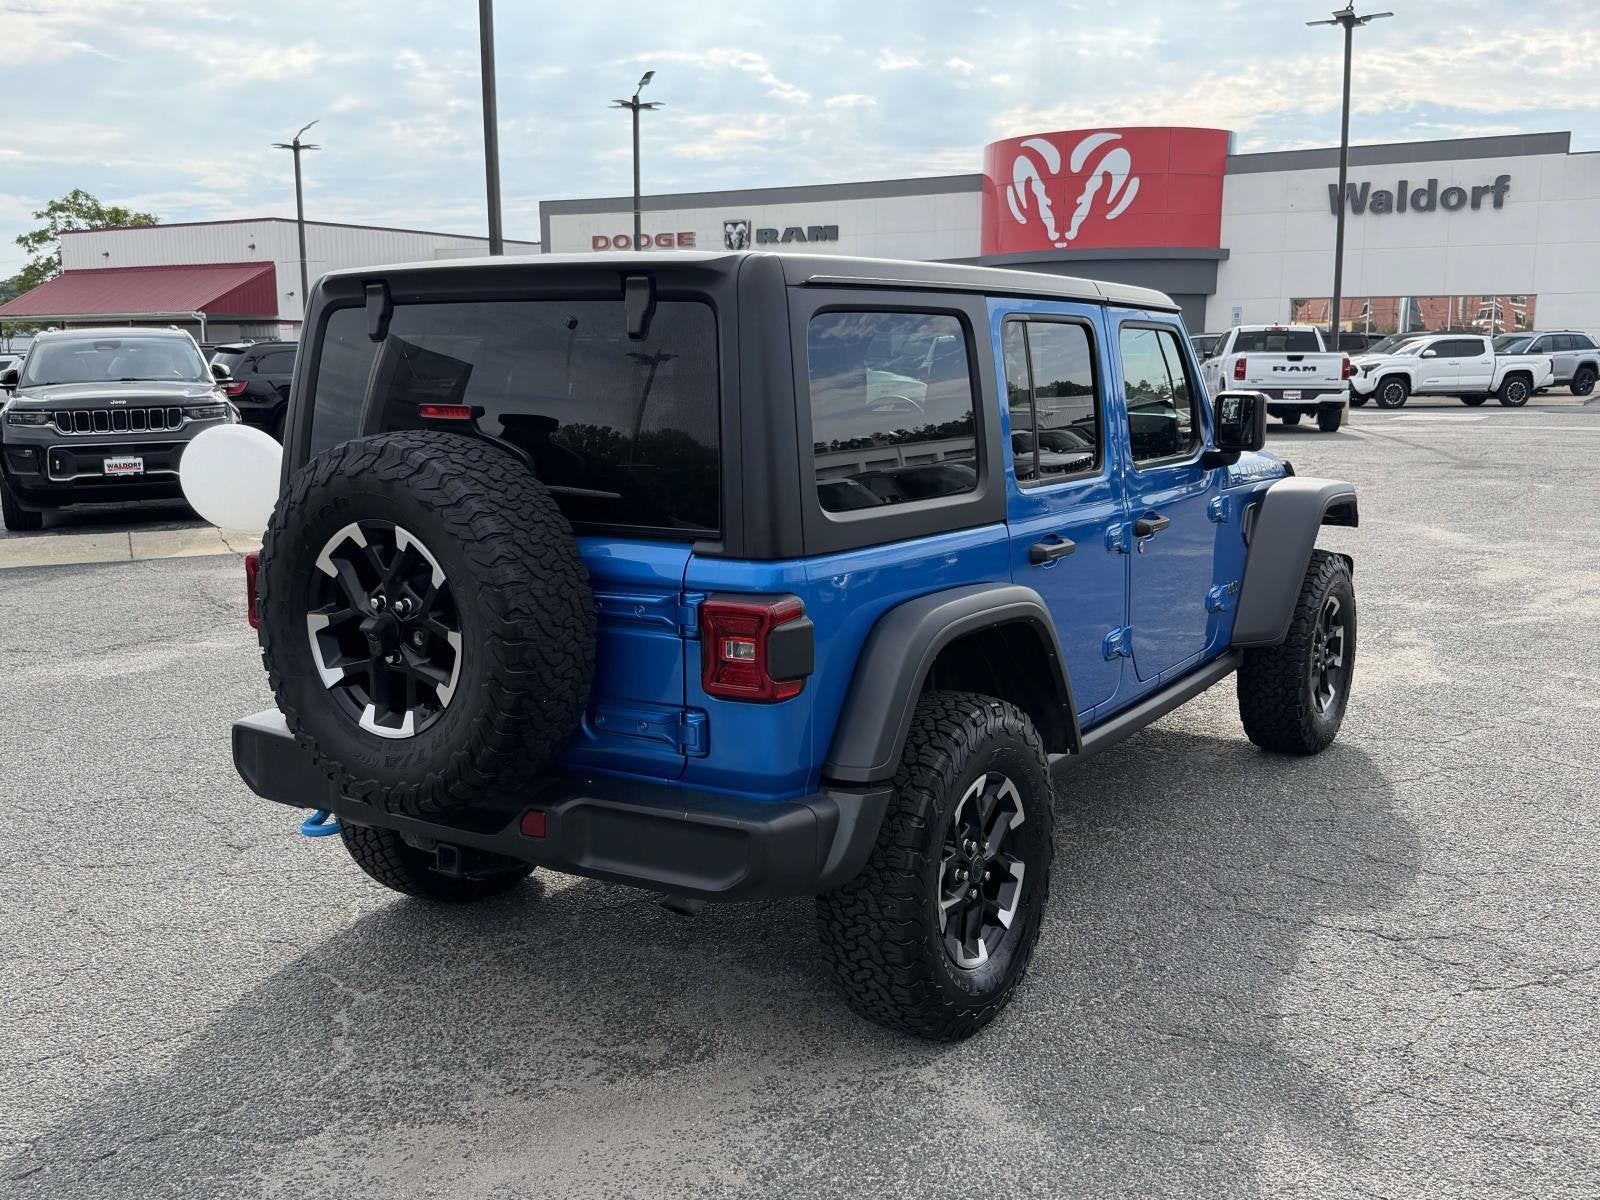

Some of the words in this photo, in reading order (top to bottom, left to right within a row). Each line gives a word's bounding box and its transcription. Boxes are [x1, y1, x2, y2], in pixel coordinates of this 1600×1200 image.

[1328, 174, 1511, 216] Waldorf
[591, 231, 697, 251] DODGE
[755, 224, 839, 245] RAM
